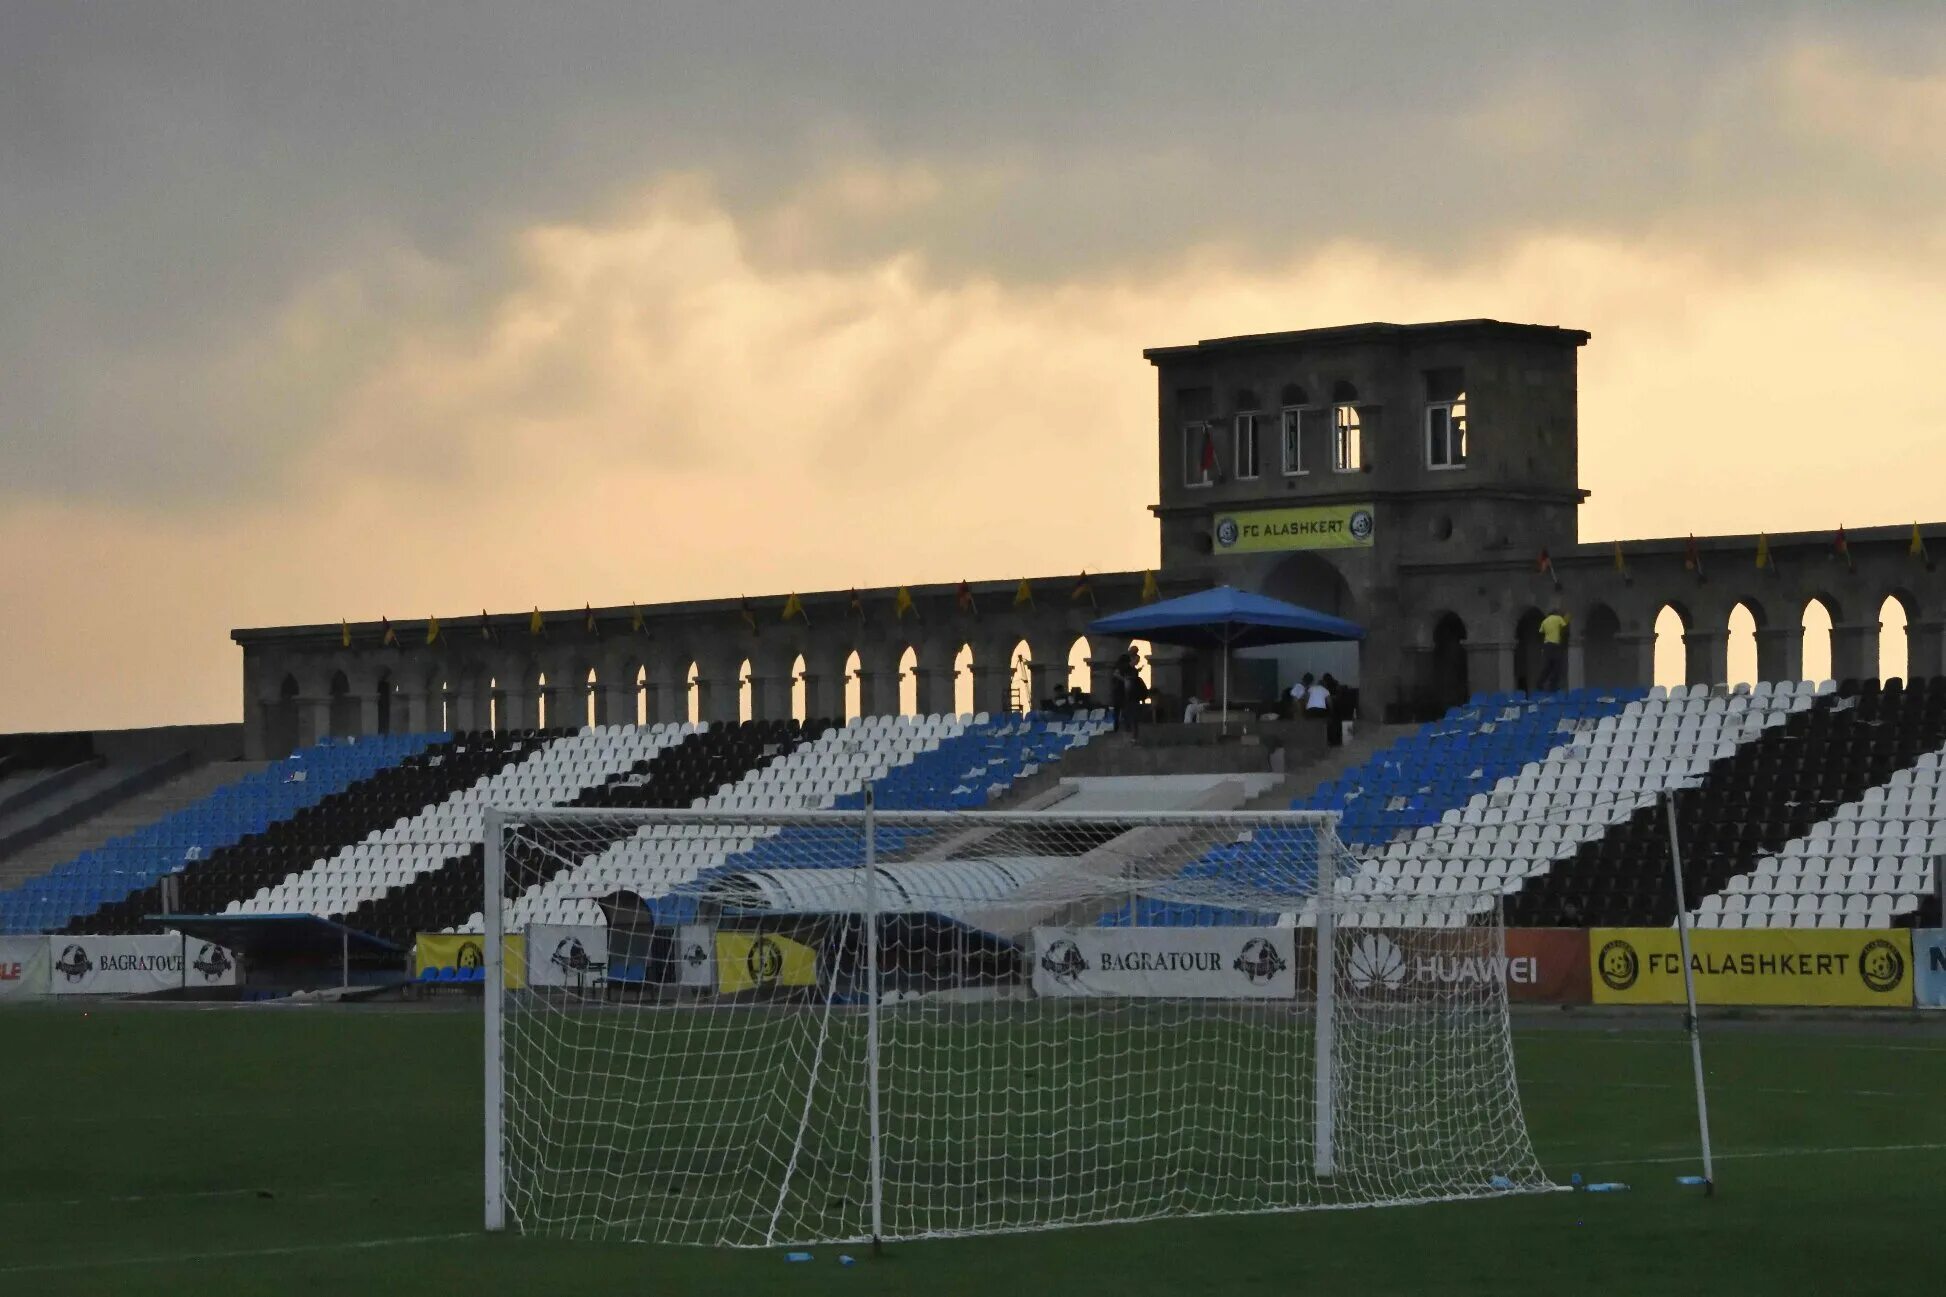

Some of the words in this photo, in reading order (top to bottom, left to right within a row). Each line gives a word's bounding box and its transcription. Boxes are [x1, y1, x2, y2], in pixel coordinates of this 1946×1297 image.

[1243, 525, 1259, 537] FC
[1264, 520, 1344, 536] ALASHKERT
[1101, 951, 1221, 971] BAGRATOUR
[1416, 956, 1537, 983] HUAWEI
[1649, 953, 1679, 974] FC
[1690, 953, 1850, 975] ALASHKERT
